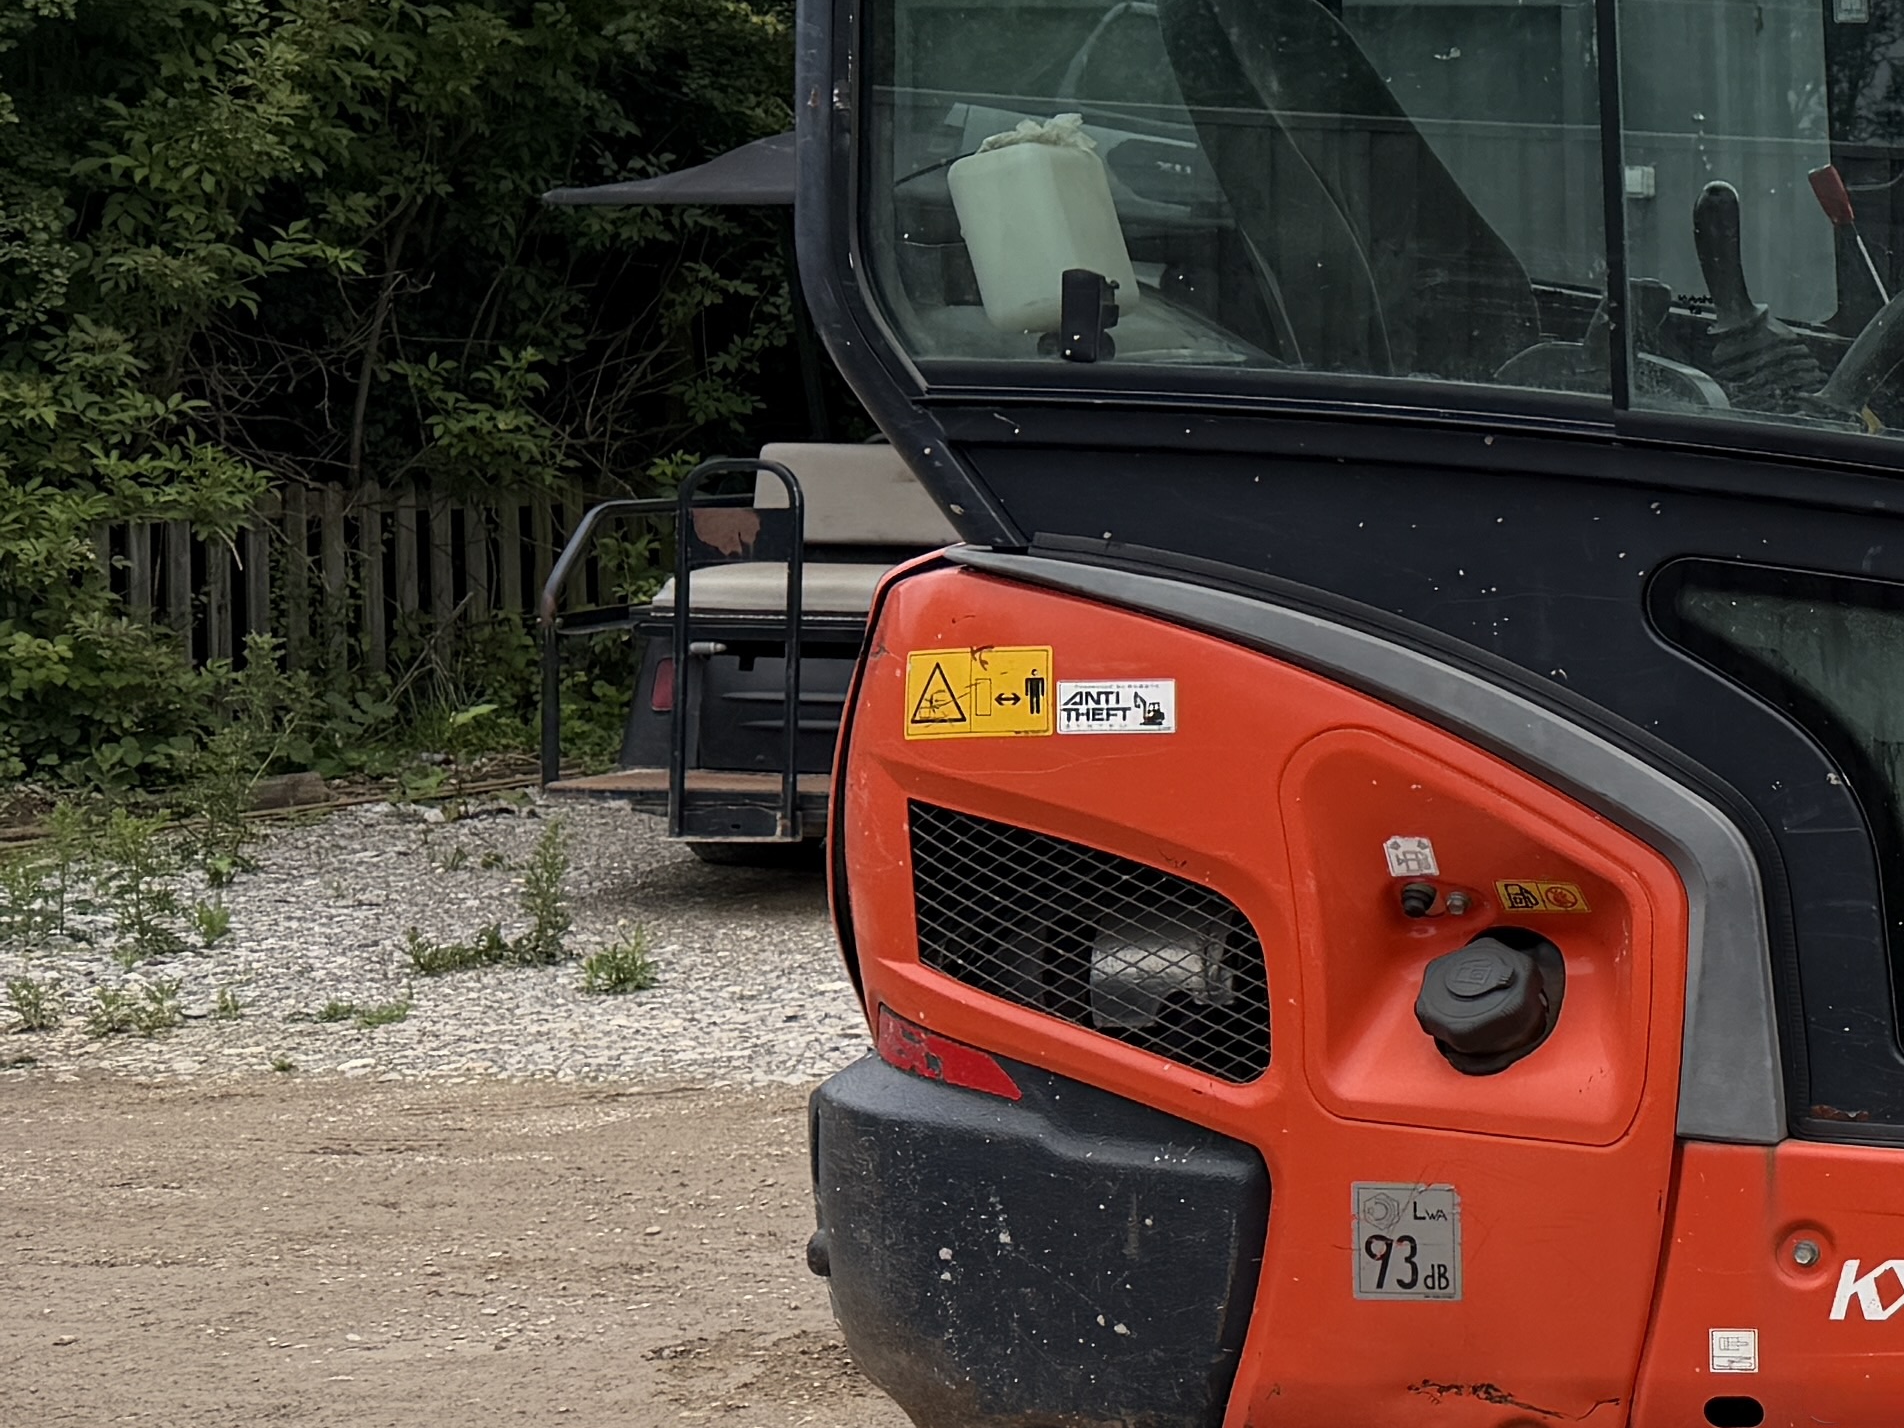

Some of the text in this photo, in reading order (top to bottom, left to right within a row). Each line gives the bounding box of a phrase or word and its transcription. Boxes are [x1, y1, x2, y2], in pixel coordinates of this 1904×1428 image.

[1062, 691, 1120, 706] ANTI
[1060, 706, 1132, 723] THEFT
[1364, 1233, 1450, 1290] 93 dB
